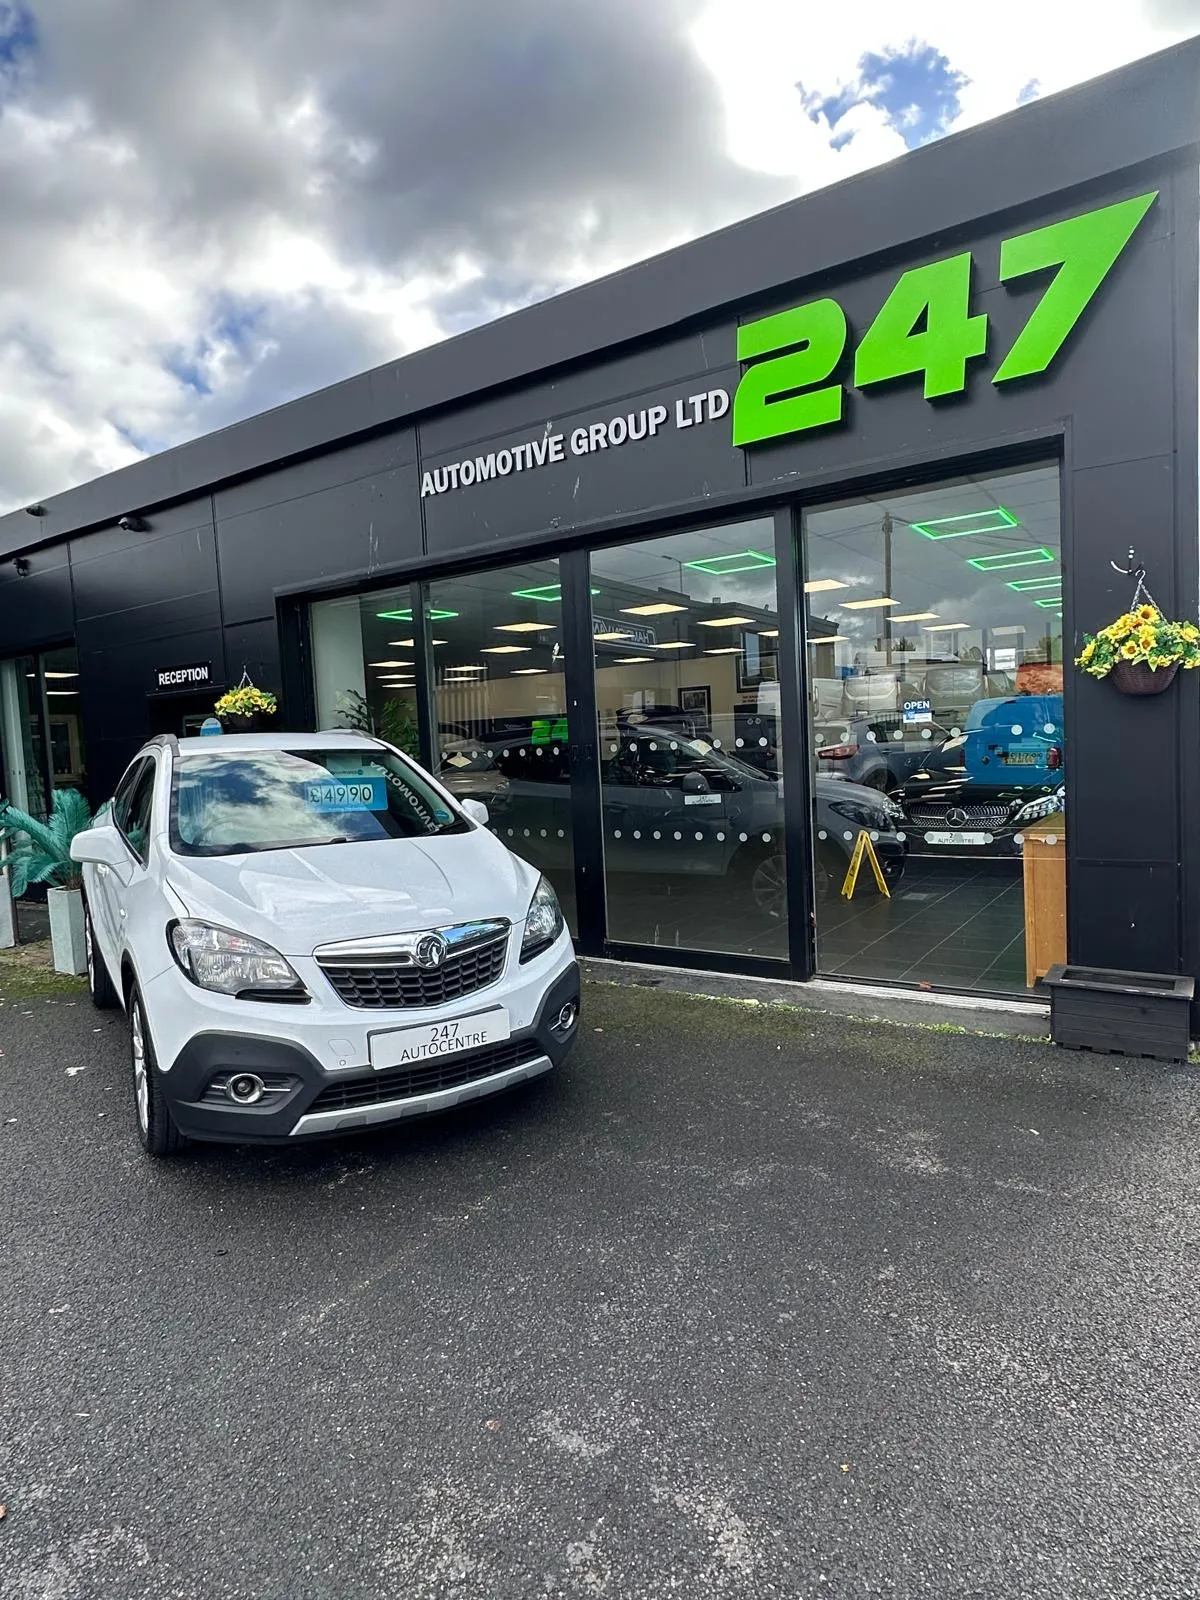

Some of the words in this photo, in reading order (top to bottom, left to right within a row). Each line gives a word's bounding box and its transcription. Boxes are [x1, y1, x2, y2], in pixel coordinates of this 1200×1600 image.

[733, 190, 1159, 447] 247
[420, 434, 565, 497] AUTOMOTIVE
[570, 405, 667, 456] GROUP
[675, 389, 730, 428] LTD
[158, 666, 208, 686] RECEPTION
[903, 700, 930, 710] OPEN
[309, 785, 373, 803] £4990
[430, 1023, 460, 1042] 247
[400, 1031, 488, 1062] AUTOCENTRE
